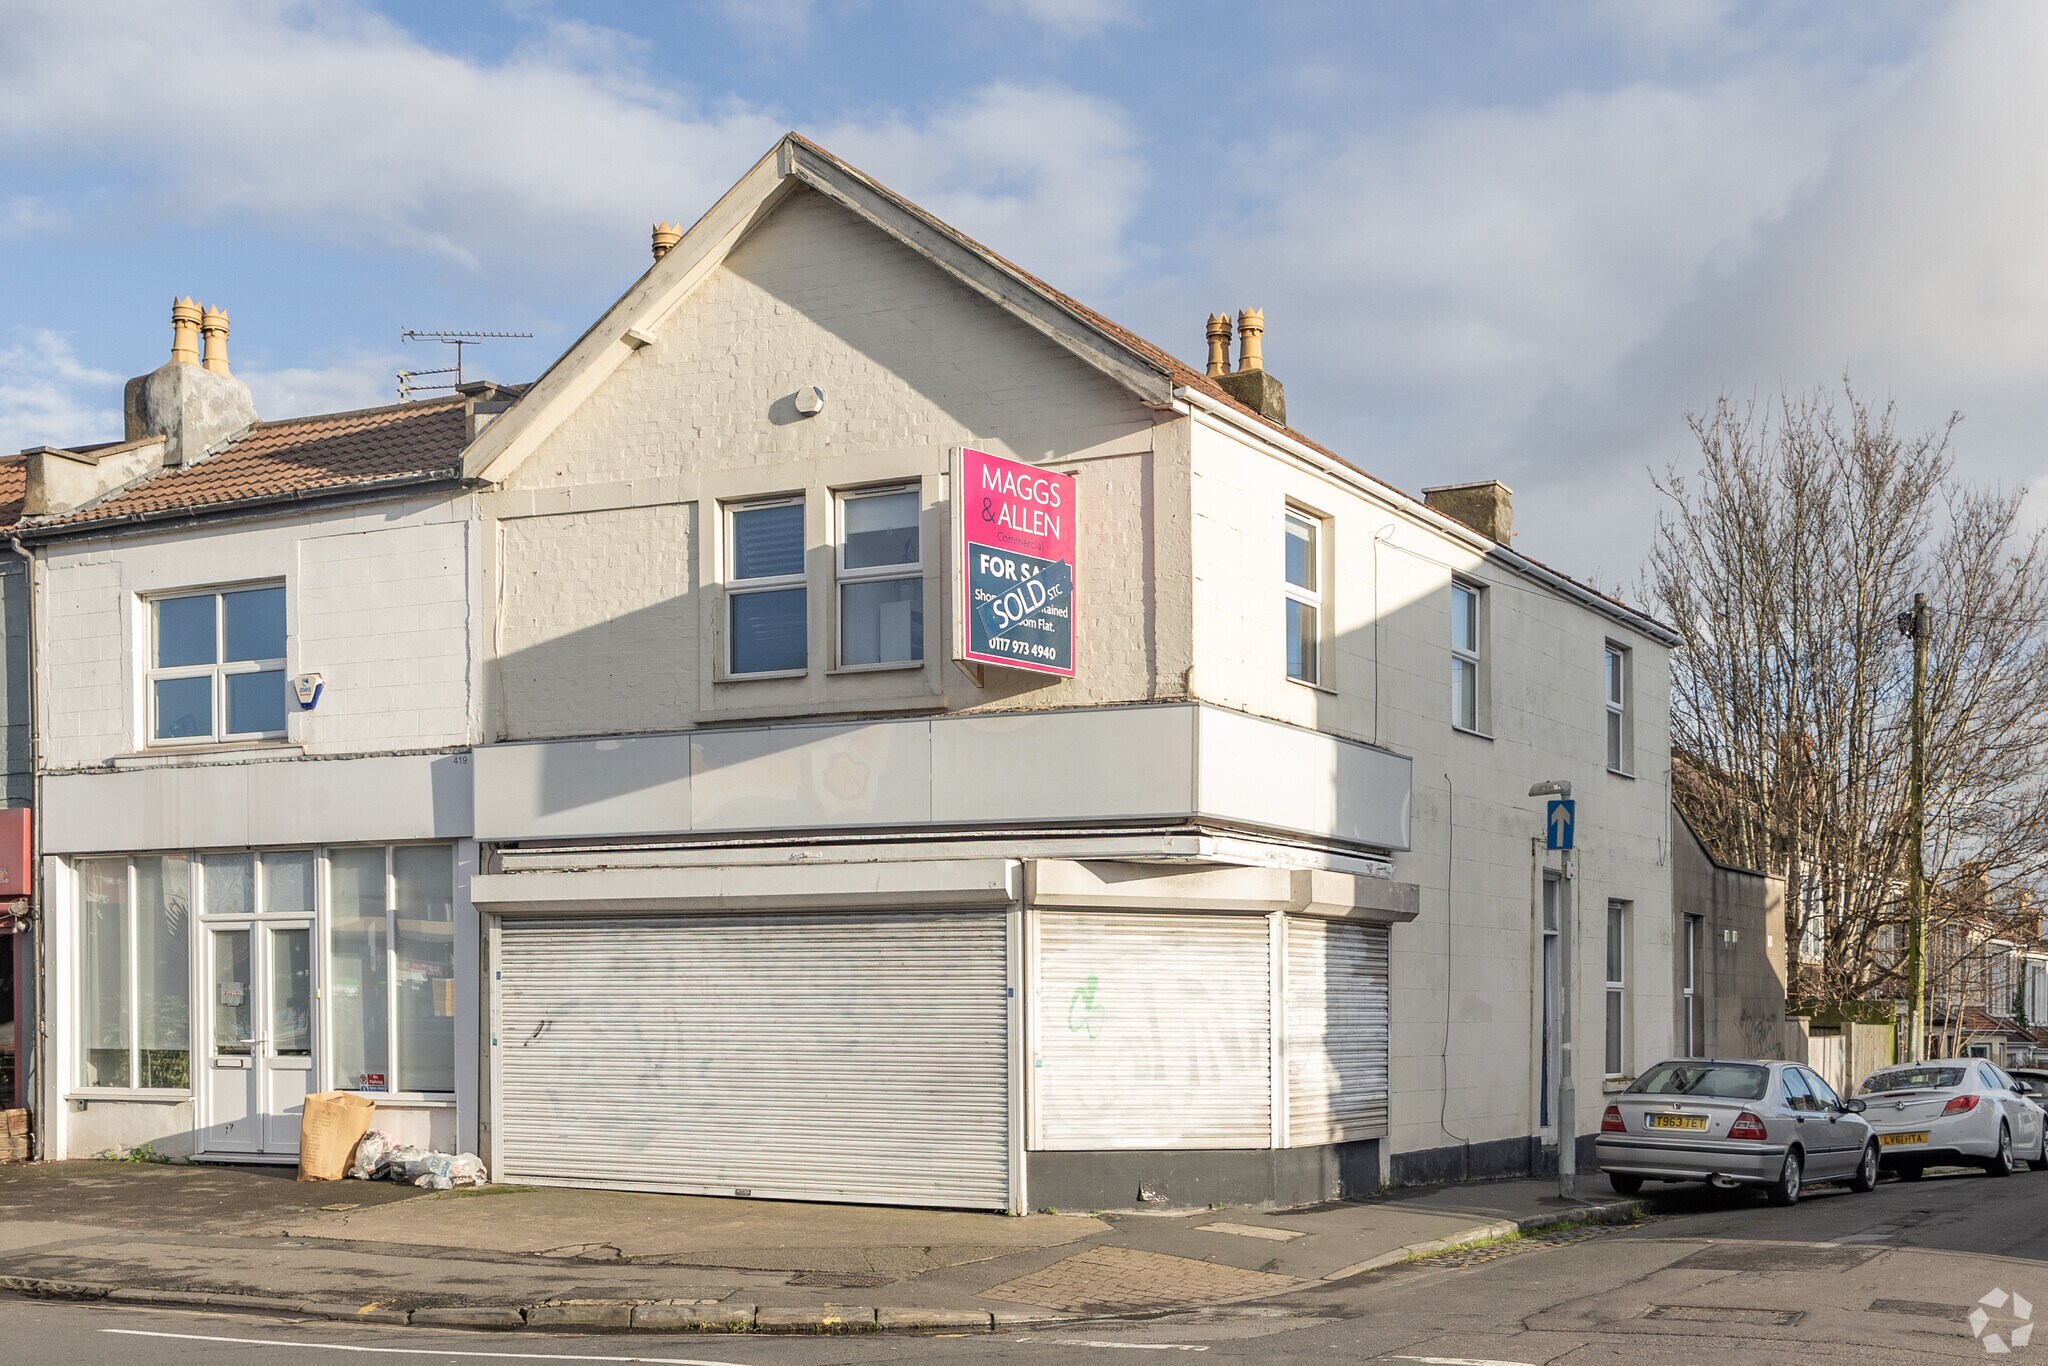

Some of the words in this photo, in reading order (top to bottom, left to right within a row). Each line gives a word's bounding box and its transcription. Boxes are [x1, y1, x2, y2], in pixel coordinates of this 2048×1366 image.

[982, 464, 1061, 508] MAGGS
[982, 497, 996, 523] &
[997, 502, 1060, 540] ALLEN
[997, 532, 1044, 551] Commercial
[980, 553, 1018, 581] FOR
[1020, 562, 1046, 582] SA
[992, 579, 1047, 629] SOLD
[1047, 583, 1064, 601] STC
[1038, 618, 1056, 632] Flat.
[988, 637, 1011, 652] 0117
[1012, 640, 1030, 655] 973
[1031, 644, 1056, 660] 4940
[453, 755, 468, 765] 419
[1656, 1116, 1683, 1127] T963
[1685, 1118, 1705, 1128] TET
[1884, 1135, 1904, 1145] LV61
[1905, 1134, 1923, 1143] HTA
